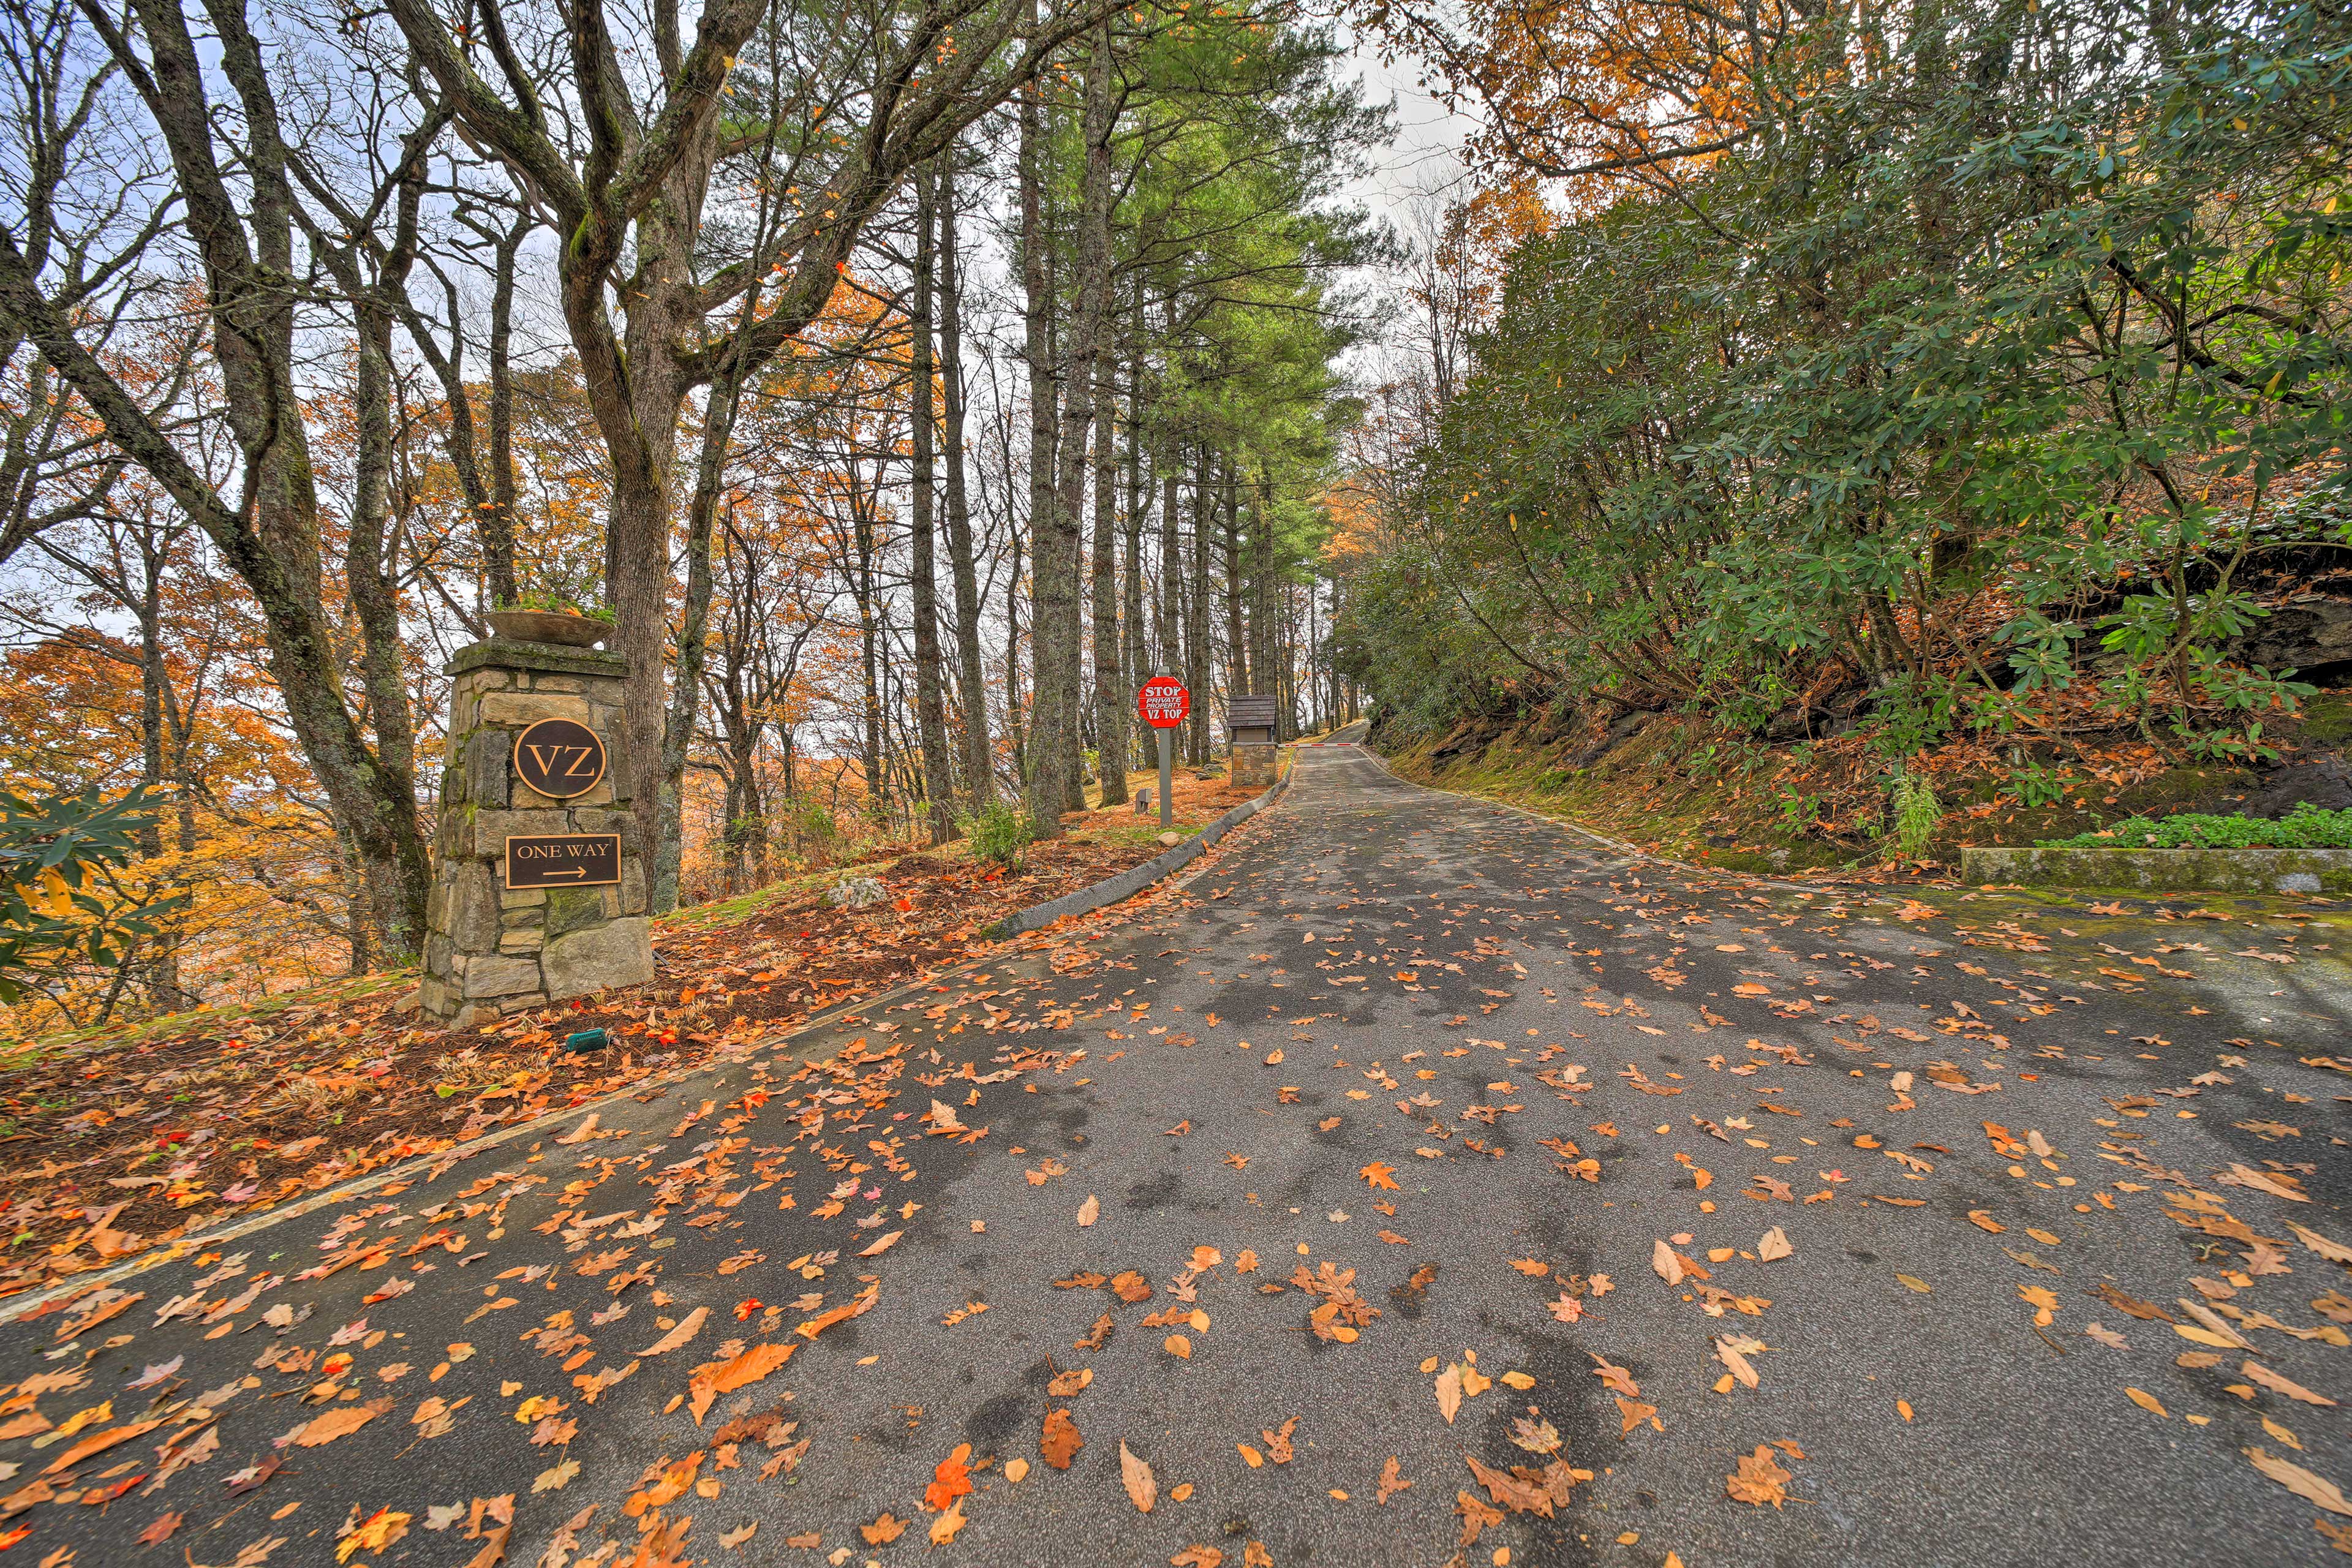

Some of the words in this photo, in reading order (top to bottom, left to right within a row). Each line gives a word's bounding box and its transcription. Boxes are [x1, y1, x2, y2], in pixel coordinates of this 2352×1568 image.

[1145, 687, 1182, 696] STOP
[1147, 709, 1160, 719] VZ
[1163, 709, 1182, 719] TOP
[526, 745, 595, 776] VZ
[518, 845, 562, 859] ONE
[567, 843, 609, 858] WAY
